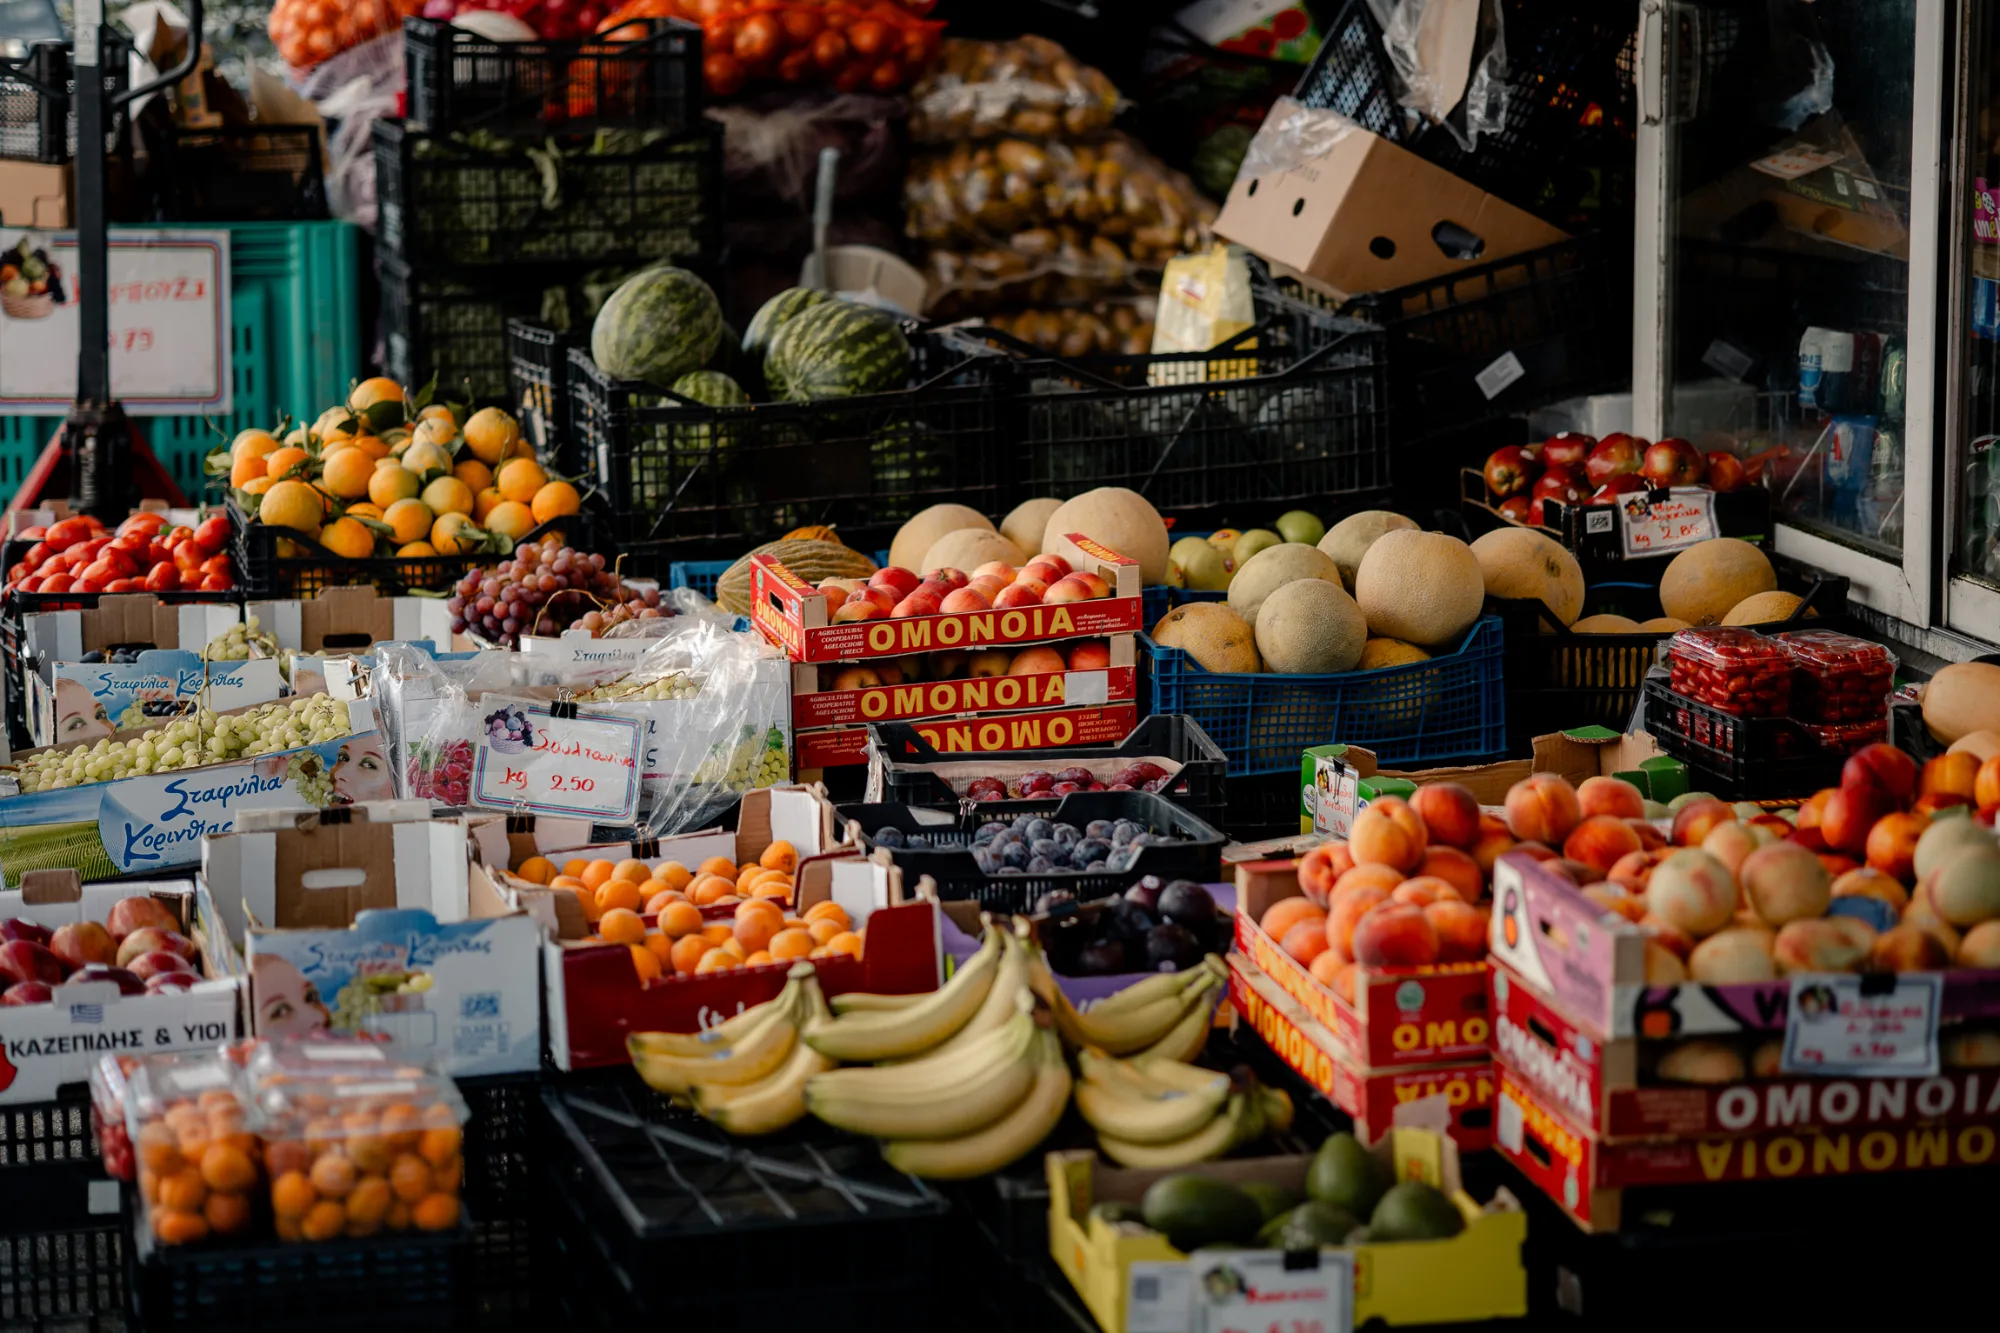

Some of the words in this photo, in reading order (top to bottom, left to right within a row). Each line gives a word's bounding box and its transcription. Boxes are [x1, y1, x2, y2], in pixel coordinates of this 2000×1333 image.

[756, 598, 799, 651] OMONOIA
[818, 626, 864, 637] AGRICULTURAL
[821, 634, 864, 643] COOPERATIVE
[869, 607, 1075, 651] OMONOIA
[176, 670, 244, 697] Κορνθίας
[860, 674, 1065, 718] OMONOIA
[812, 701, 855, 710] COOPERATIVE
[160, 774, 282, 822] Σταφύλια
[10, 1029, 143, 1058] ΚΑΖΕΠΙΔΗΣ
[155, 1027, 171, 1045] &
[184, 1022, 227, 1042] ΥΙΟΙ
[1697, 1125, 1996, 1181] OMONOIA
